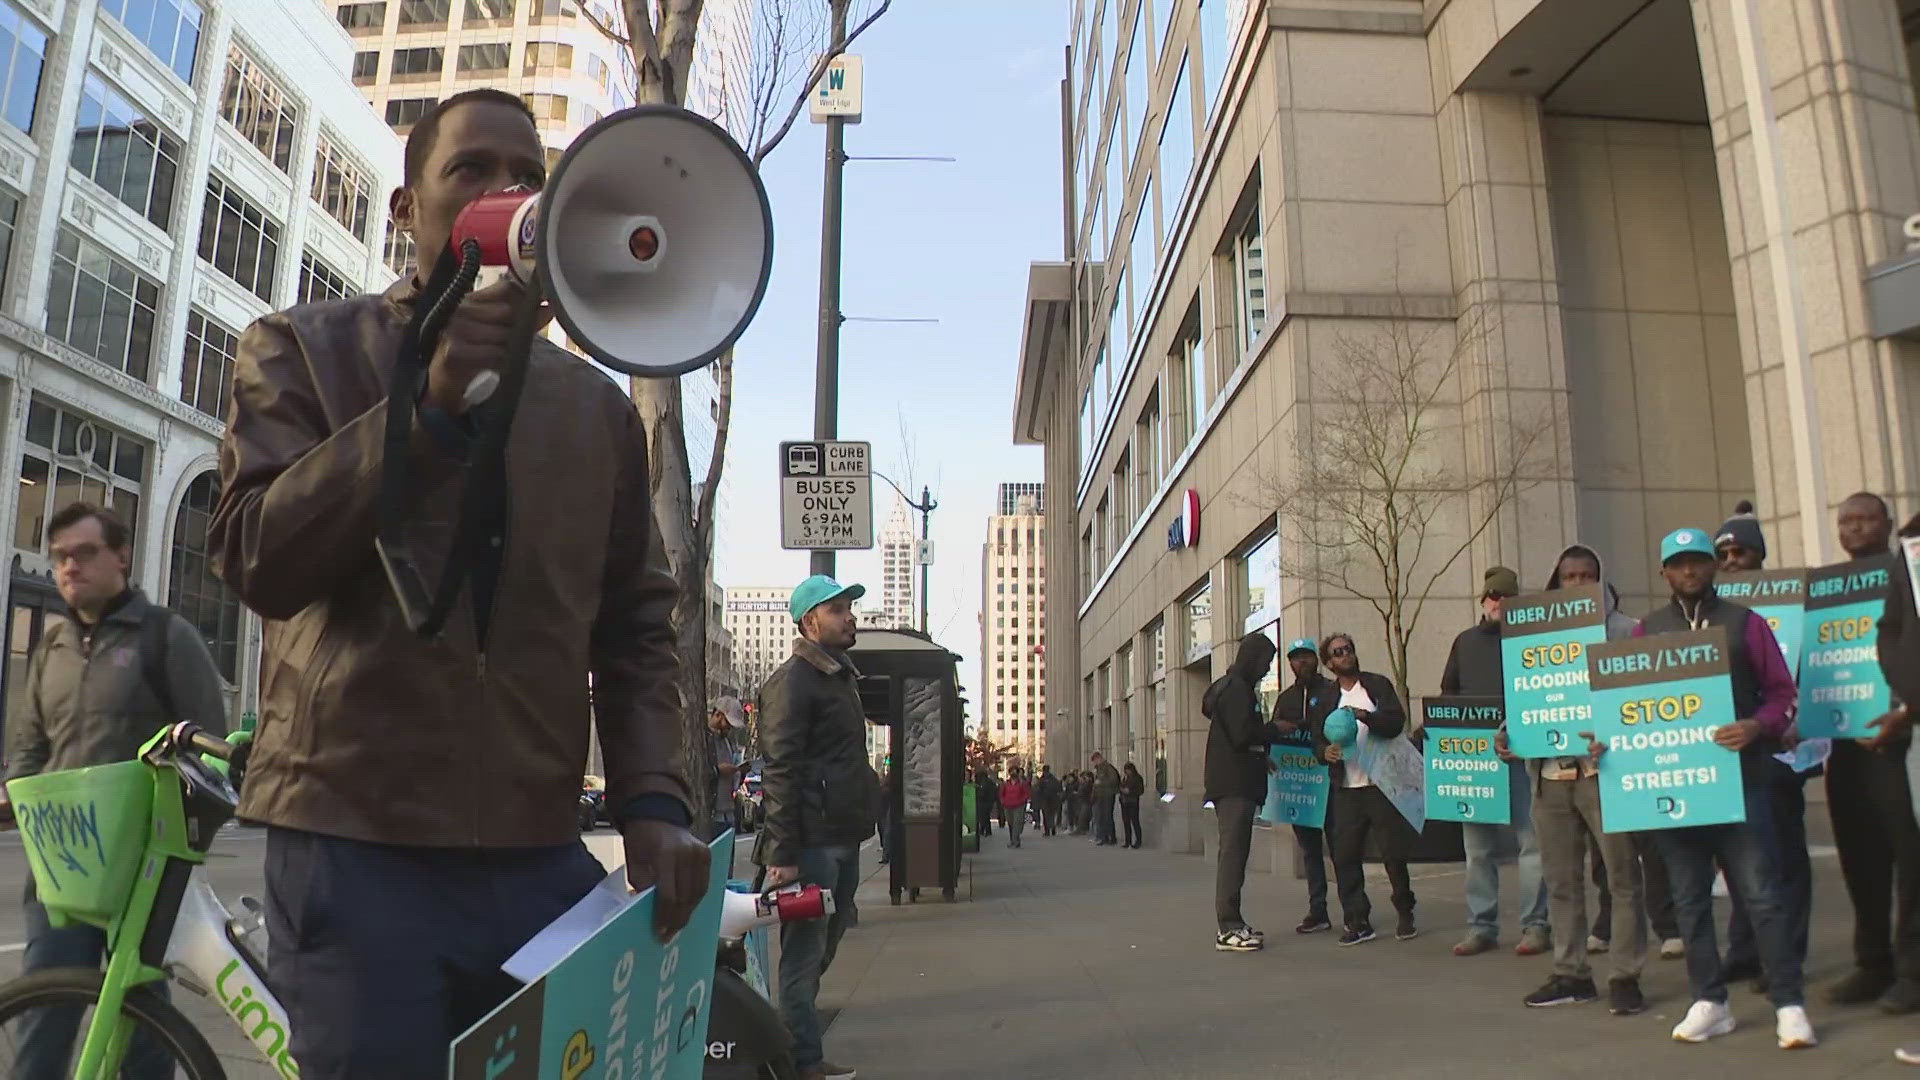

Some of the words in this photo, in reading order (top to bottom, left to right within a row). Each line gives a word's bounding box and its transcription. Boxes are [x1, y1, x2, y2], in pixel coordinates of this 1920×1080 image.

[829, 69, 845, 90] W
[830, 447, 864, 458] CURB
[830, 461, 864, 472] LANE
[796, 481, 856, 494] BUSES
[803, 497, 849, 510] ONLY
[1819, 616, 1873, 643] STOP
[1522, 641, 1582, 669] STOP
[1546, 693, 1565, 702] OUR
[1521, 705, 1592, 725] STREETS!
[1621, 693, 1702, 726] STOP
[1439, 738, 1488, 755] STOP
[1281, 753, 1319, 769] STOP
[1432, 759, 1499, 773] FLOODING
[1654, 753, 1680, 765] OUR
[1621, 765, 1717, 792] STREETS!
[1437, 785, 1495, 799] STREETS!
